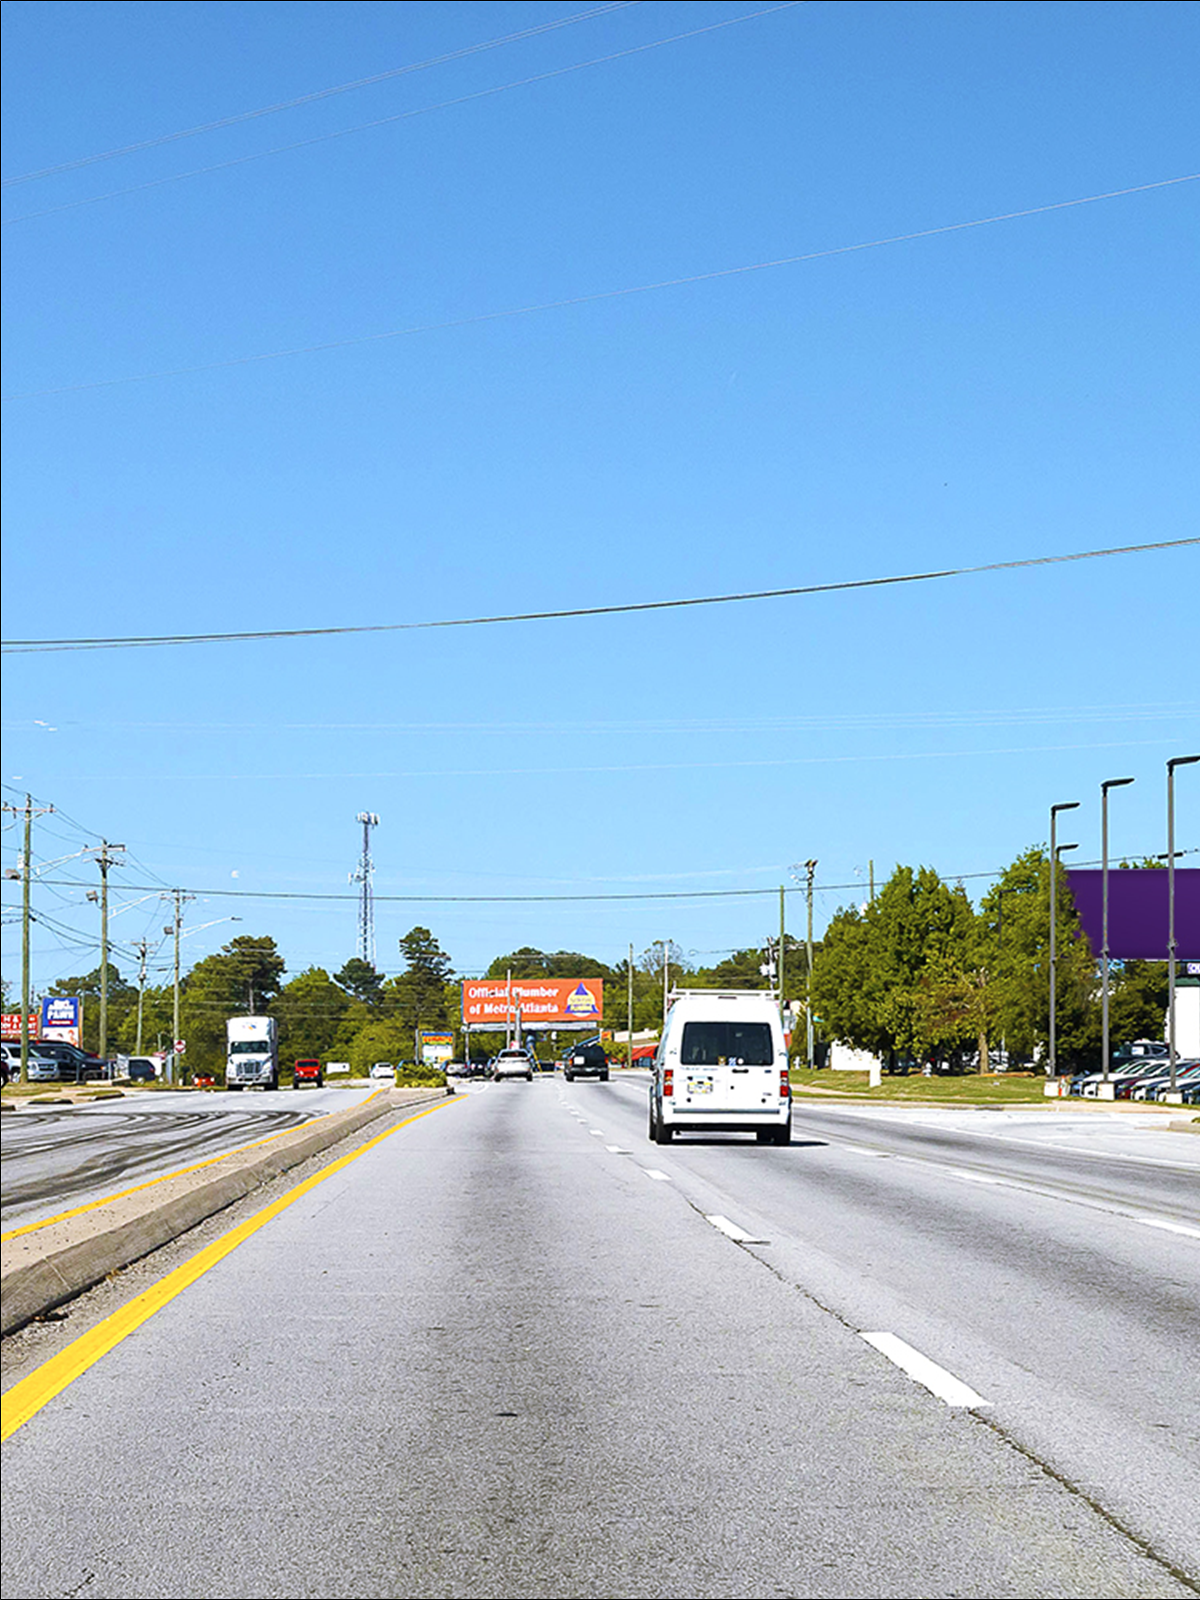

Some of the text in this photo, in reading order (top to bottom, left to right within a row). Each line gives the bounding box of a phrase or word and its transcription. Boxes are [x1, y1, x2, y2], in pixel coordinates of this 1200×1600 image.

[468, 986, 559, 998] Official Plumber
[469, 1003, 481, 1014] of
[483, 1003, 517, 1013] Metro
[519, 1002, 559, 1013] Atlanta
